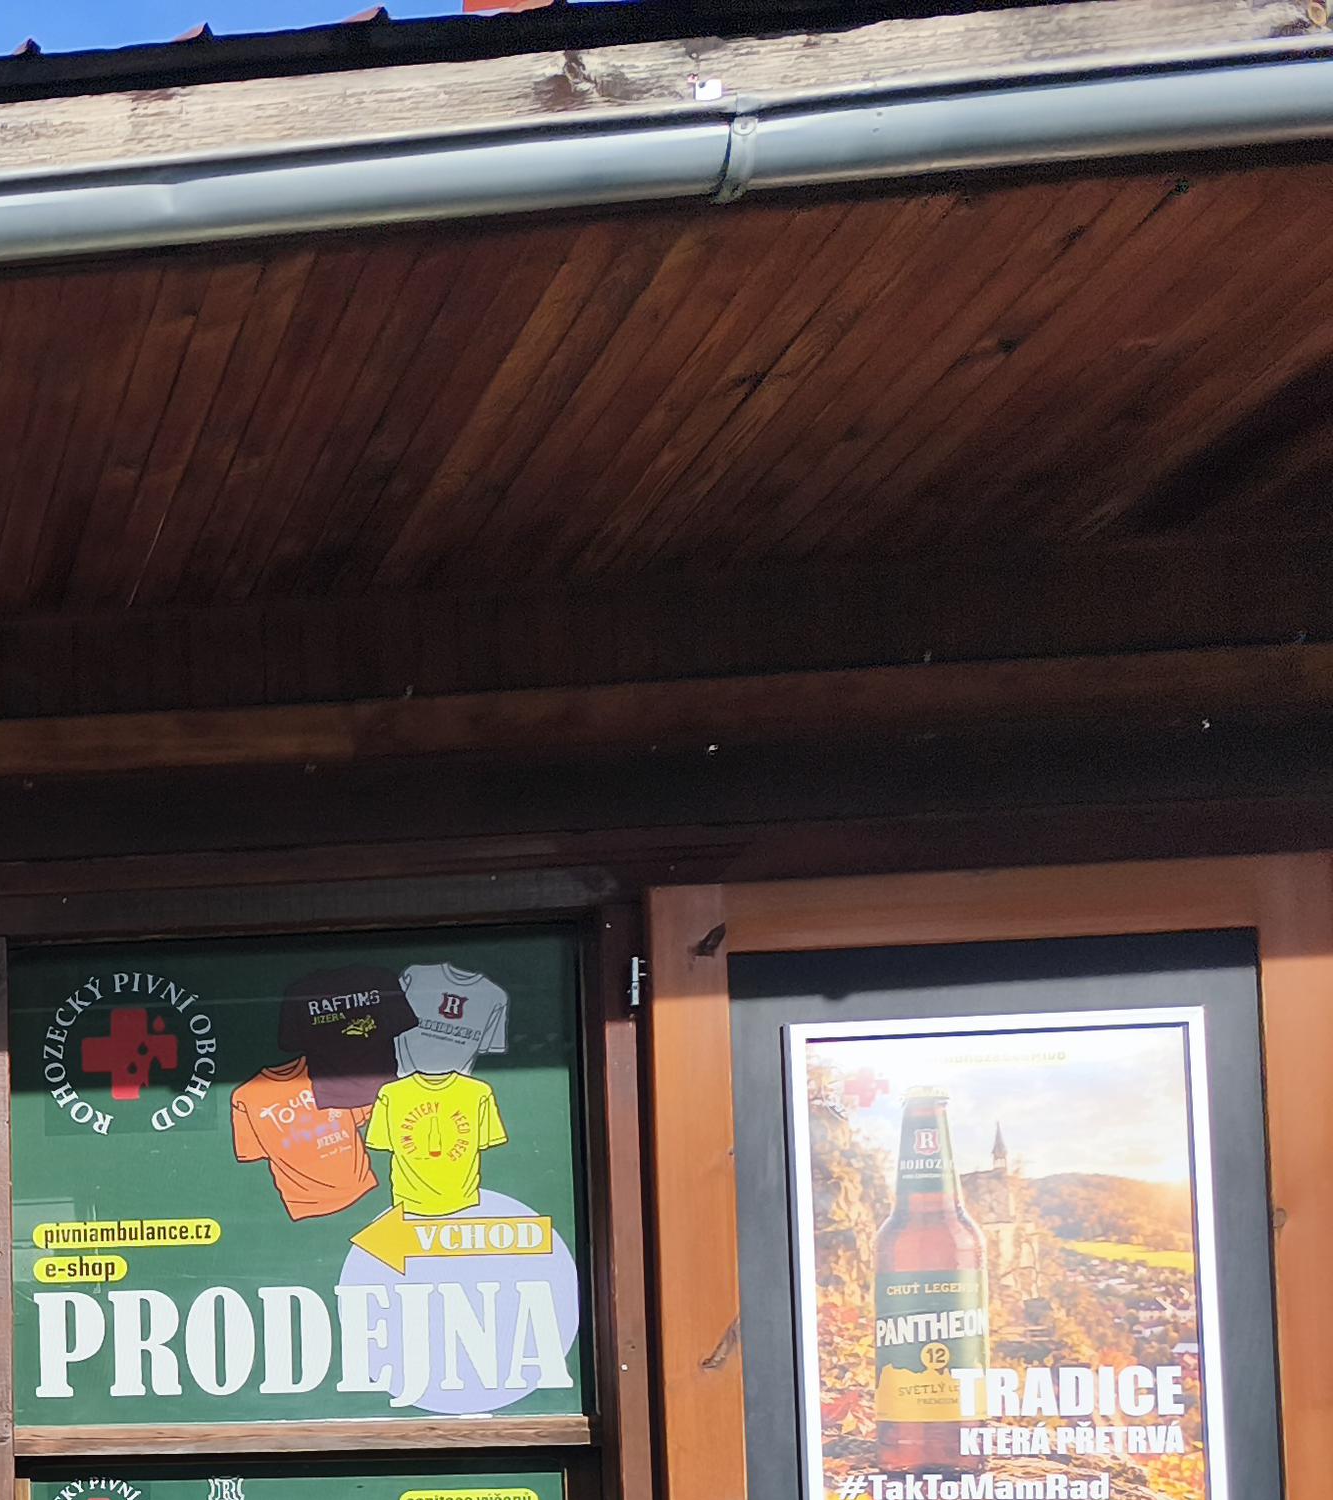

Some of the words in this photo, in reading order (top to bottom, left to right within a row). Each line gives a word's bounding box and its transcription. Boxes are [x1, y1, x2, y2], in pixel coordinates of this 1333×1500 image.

[113, 972, 200, 1013] PIVNÍ
[308, 990, 381, 1017] RAFTING
[43, 976, 114, 1136] ROHOZECKÝ
[150, 1014, 217, 1131] OBCHOD
[44, 1221, 213, 1249] pivniambulance.cz
[413, 1220, 545, 1252] VCHOD
[44, 1258, 116, 1282] e-shop
[33, 1280, 575, 1409] PRODEJNA
[926, 1348, 946, 1364] 12
[950, 1365, 1185, 1417] TRADICE
[959, 1420, 1052, 1456] KTERÁ
[1056, 1419, 1185, 1456] PŘETRVÁ
[837, 1472, 1111, 1500] #TakToMamRad
